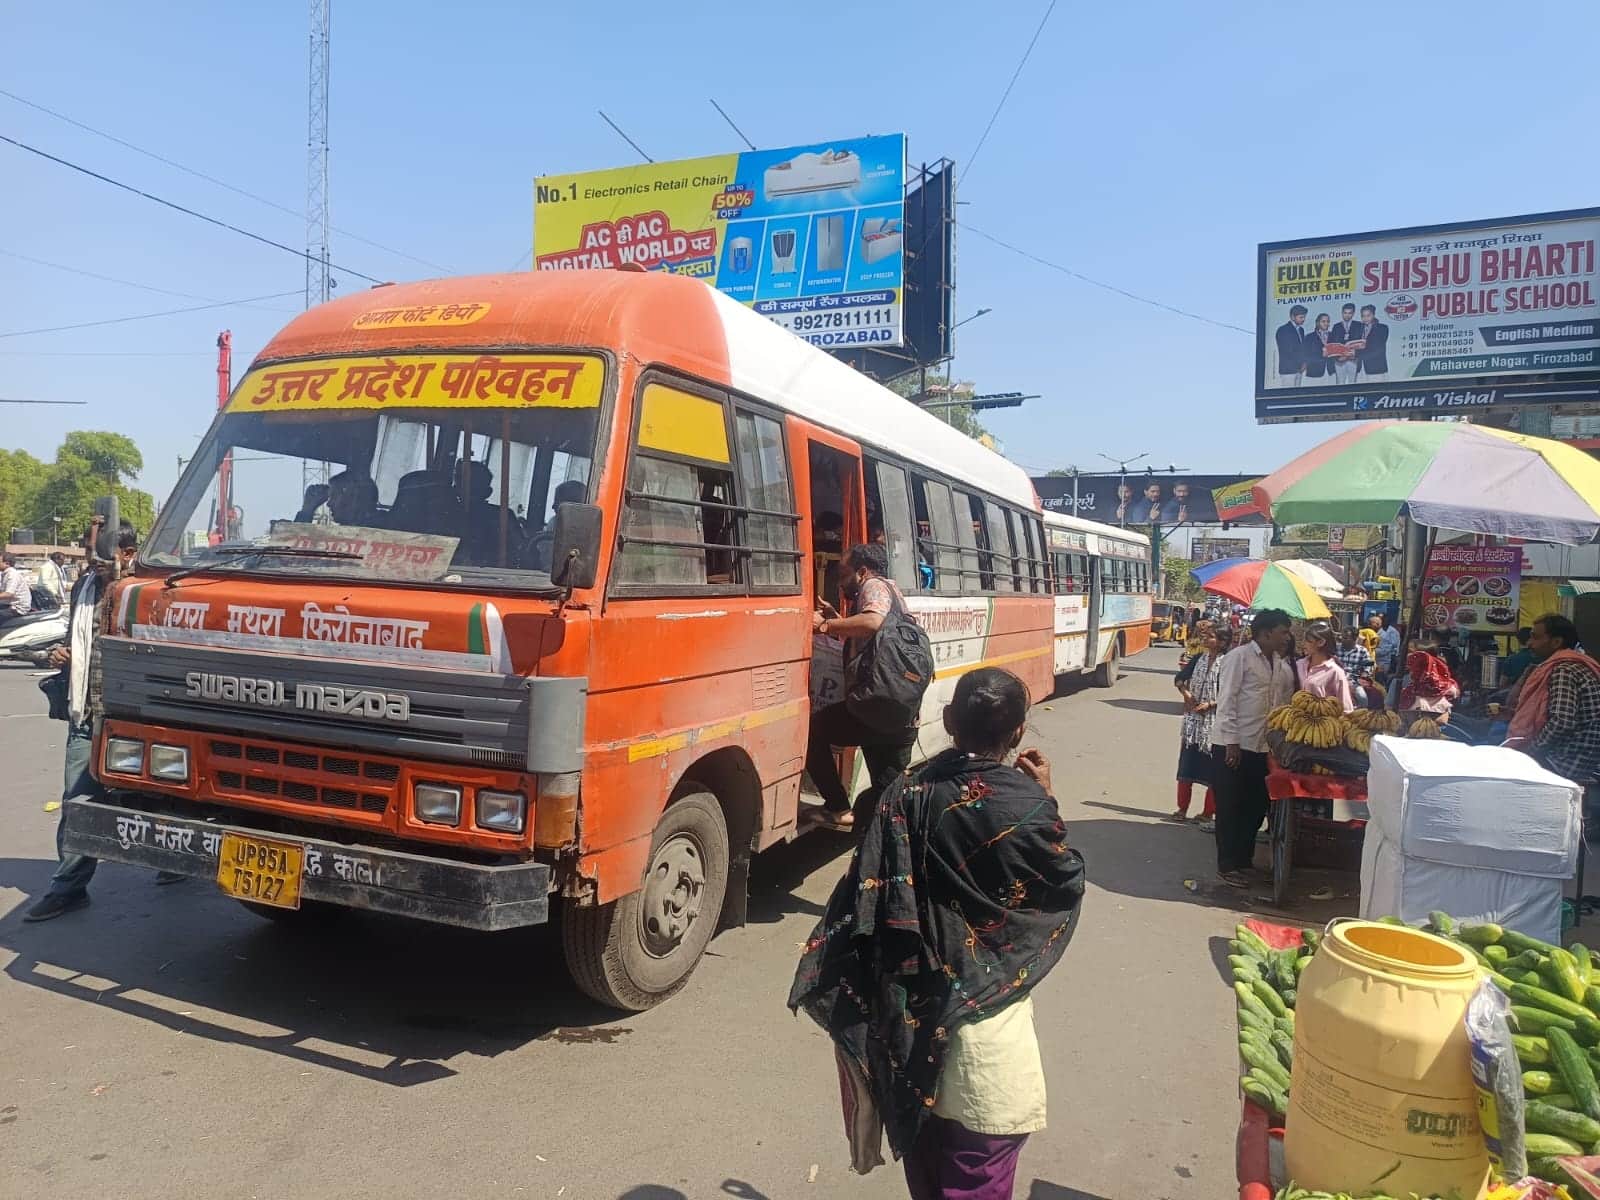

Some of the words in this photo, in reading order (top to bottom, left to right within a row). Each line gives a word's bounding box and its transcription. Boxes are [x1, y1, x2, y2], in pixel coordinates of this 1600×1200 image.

[537, 182, 578, 204] No.1
[584, 184, 650, 199] Electronics
[653, 178, 688, 192] Retail
[692, 173, 728, 187] Chain
[716, 192, 752, 210] 50%
[720, 209, 739, 219] OFF
[585, 229, 611, 249] AC
[616, 224, 633, 245] ही
[636, 217, 664, 240] AC
[540, 252, 615, 271] DIGITAL
[617, 235, 687, 264] WORLD
[690, 235, 713, 251] पर
[1277, 262, 1324, 281] FULLY
[1328, 260, 1353, 277] AC
[1363, 252, 1471, 294] SHISHU
[1479, 239, 1595, 283] BHARTI
[761, 299, 778, 312] की
[1277, 295, 1318, 305] PLAYWAY
[1421, 289, 1500, 319] PUBLIC
[1504, 281, 1595, 312] SCHOOL
[794, 308, 892, 330] 9927811111
[1495, 326, 1539, 341] English
[1542, 324, 1594, 338] Medium
[1430, 357, 1488, 371] Mahaveer
[1491, 354, 1529, 369] Nagar,
[1533, 350, 1593, 365] Firozabad
[251, 366, 339, 406] उत्तर
[337, 358, 438, 402] प्रदेश
[441, 356, 585, 402] परिवहन
[1374, 395, 1425, 409] Annu
[1433, 390, 1496, 407] Vishal
[116, 814, 152, 851] बुरी
[235, 841, 290, 876] UP85A
[232, 868, 285, 902] T5127
